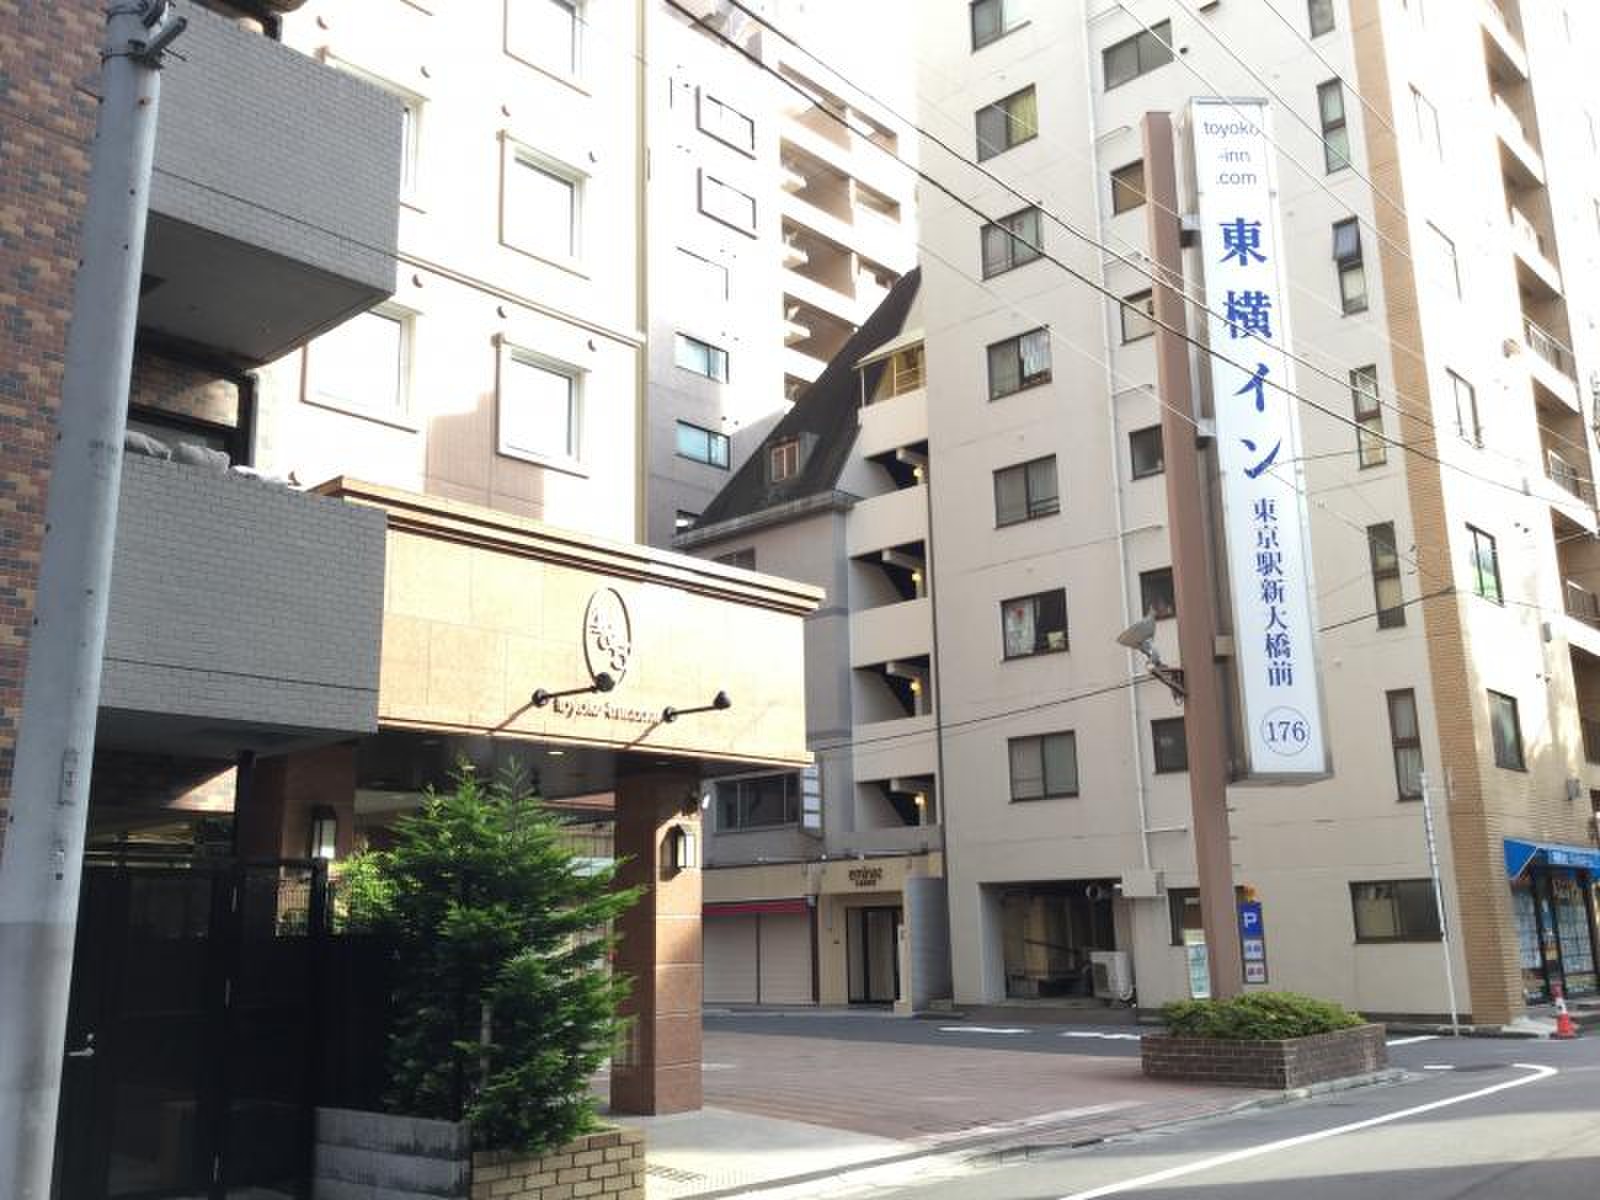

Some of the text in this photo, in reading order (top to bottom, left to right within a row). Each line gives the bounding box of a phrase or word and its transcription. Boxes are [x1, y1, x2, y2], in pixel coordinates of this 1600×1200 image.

[1204, 121, 1260, 137] toyoko
[1218, 217, 1282, 479] 東横イン
[1253, 497, 1294, 687] 東京駅新大橋前
[1267, 721, 1307, 742] 176
